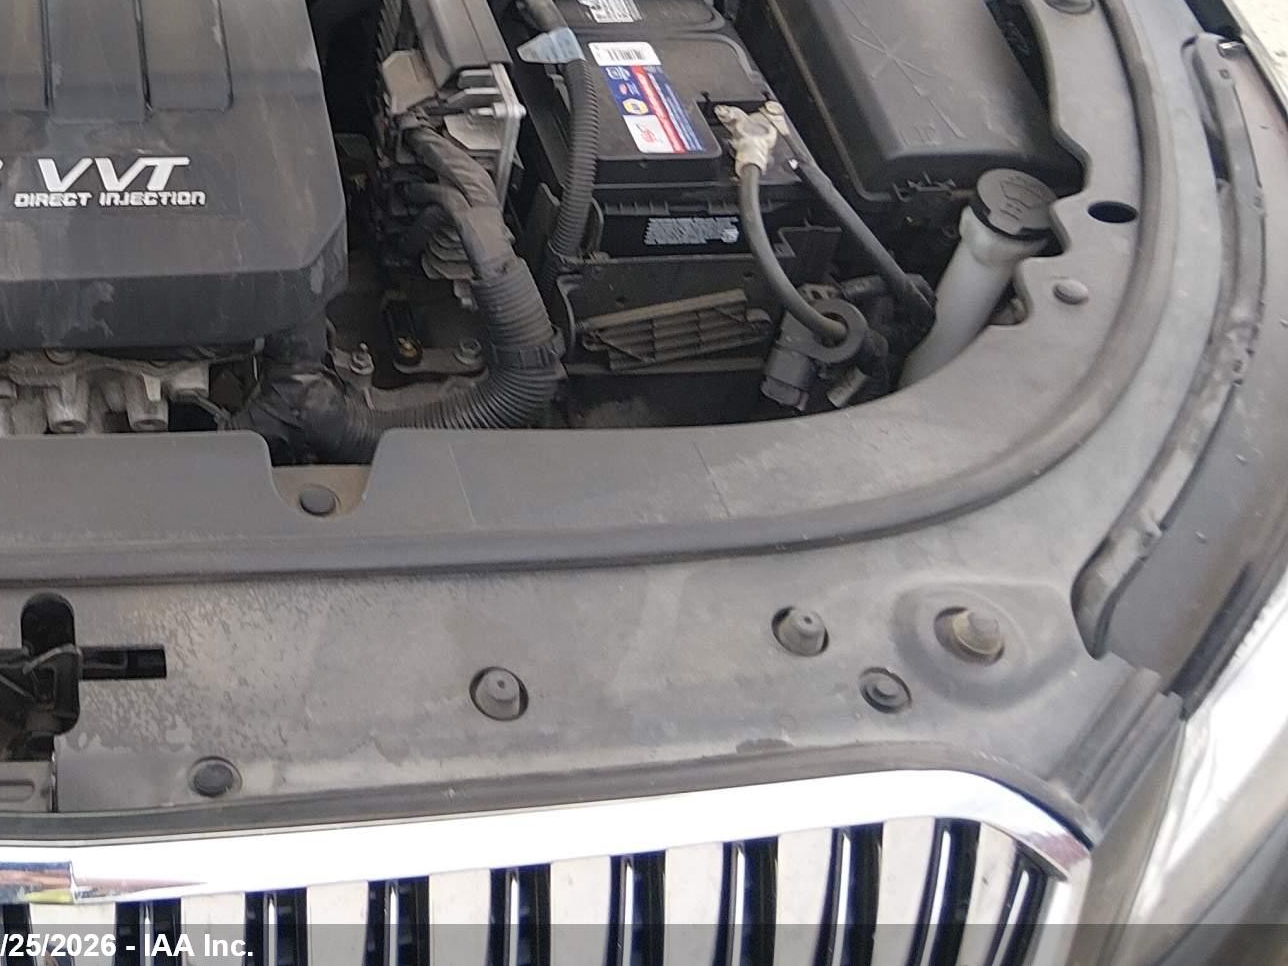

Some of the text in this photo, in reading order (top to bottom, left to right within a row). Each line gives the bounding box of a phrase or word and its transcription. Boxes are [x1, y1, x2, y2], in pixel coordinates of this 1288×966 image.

[38, 157, 190, 192] VVT
[14, 191, 206, 208] DIRECT INJECTION
